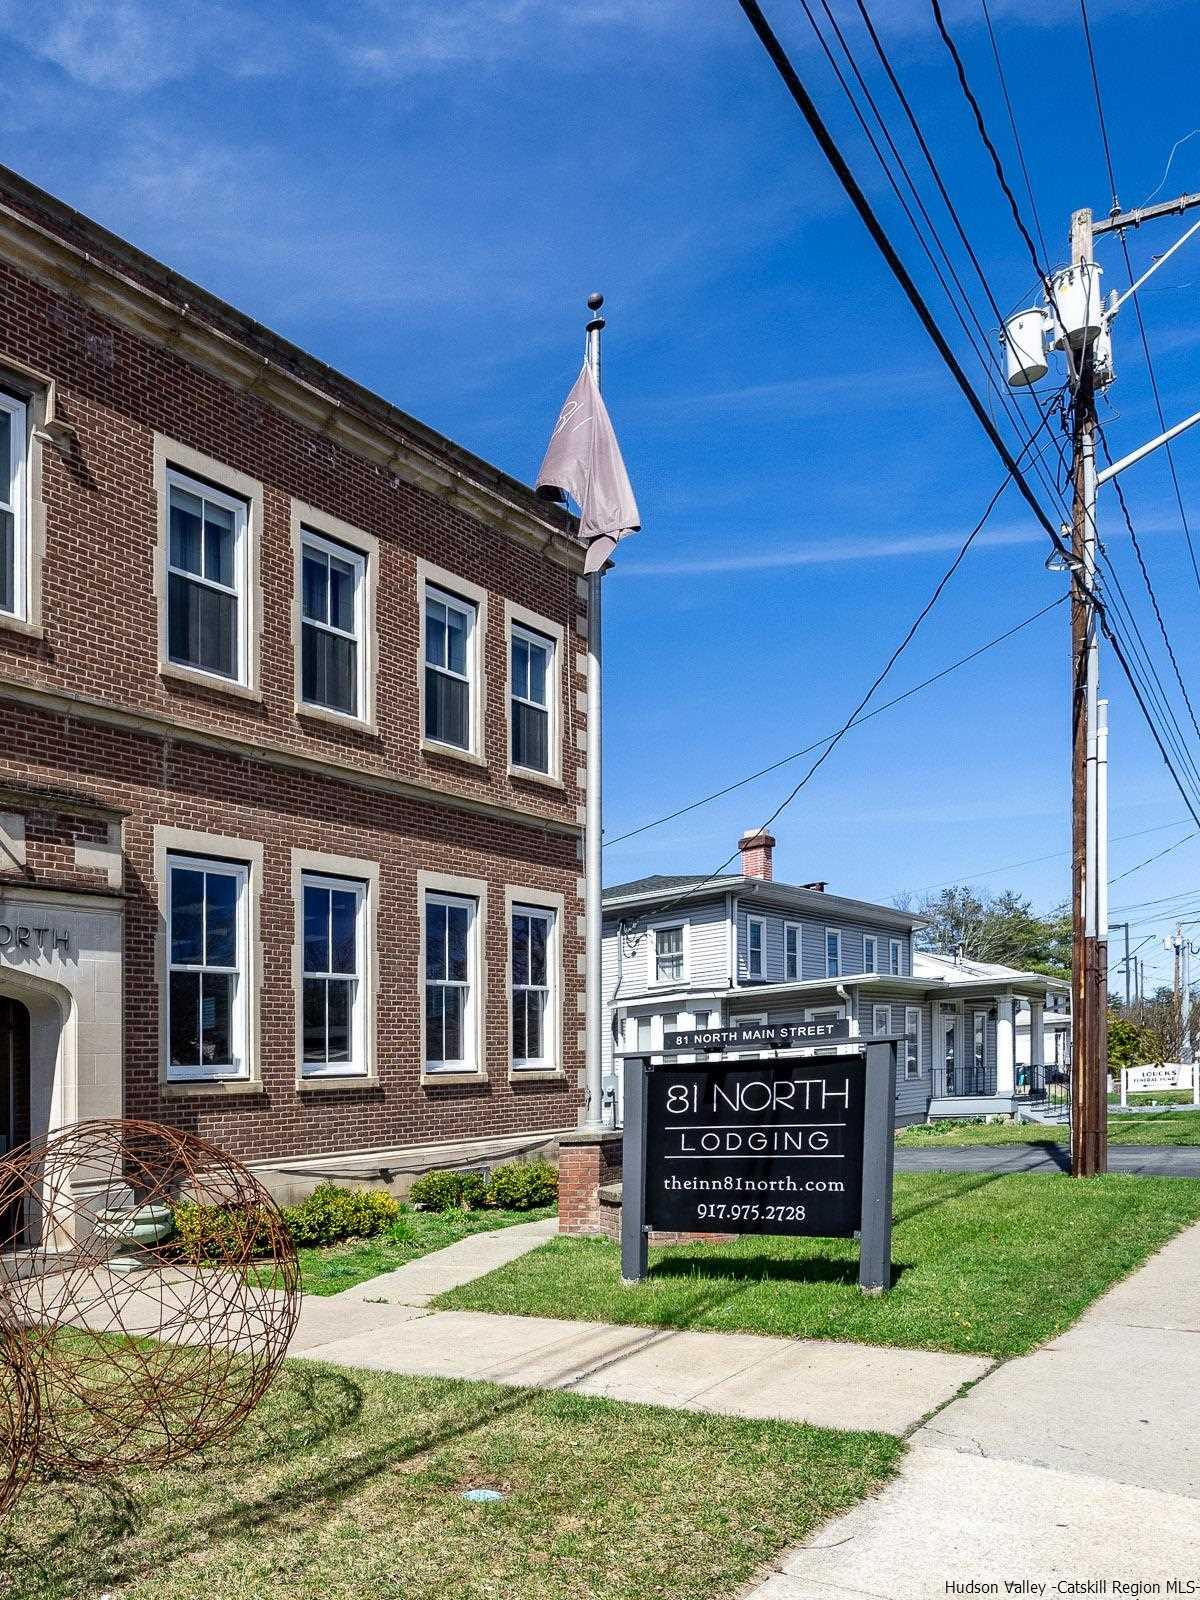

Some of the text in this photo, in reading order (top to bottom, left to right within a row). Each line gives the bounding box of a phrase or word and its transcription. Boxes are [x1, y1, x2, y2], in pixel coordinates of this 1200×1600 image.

[676, 1024, 835, 1045] 81 NORTH MAIN STREET
[666, 1078, 849, 1114] 81 NORTH
[681, 1131, 829, 1151] LODGING
[663, 1175, 846, 1192] theinn81north.com
[697, 1204, 806, 1221] 917.975.2728
